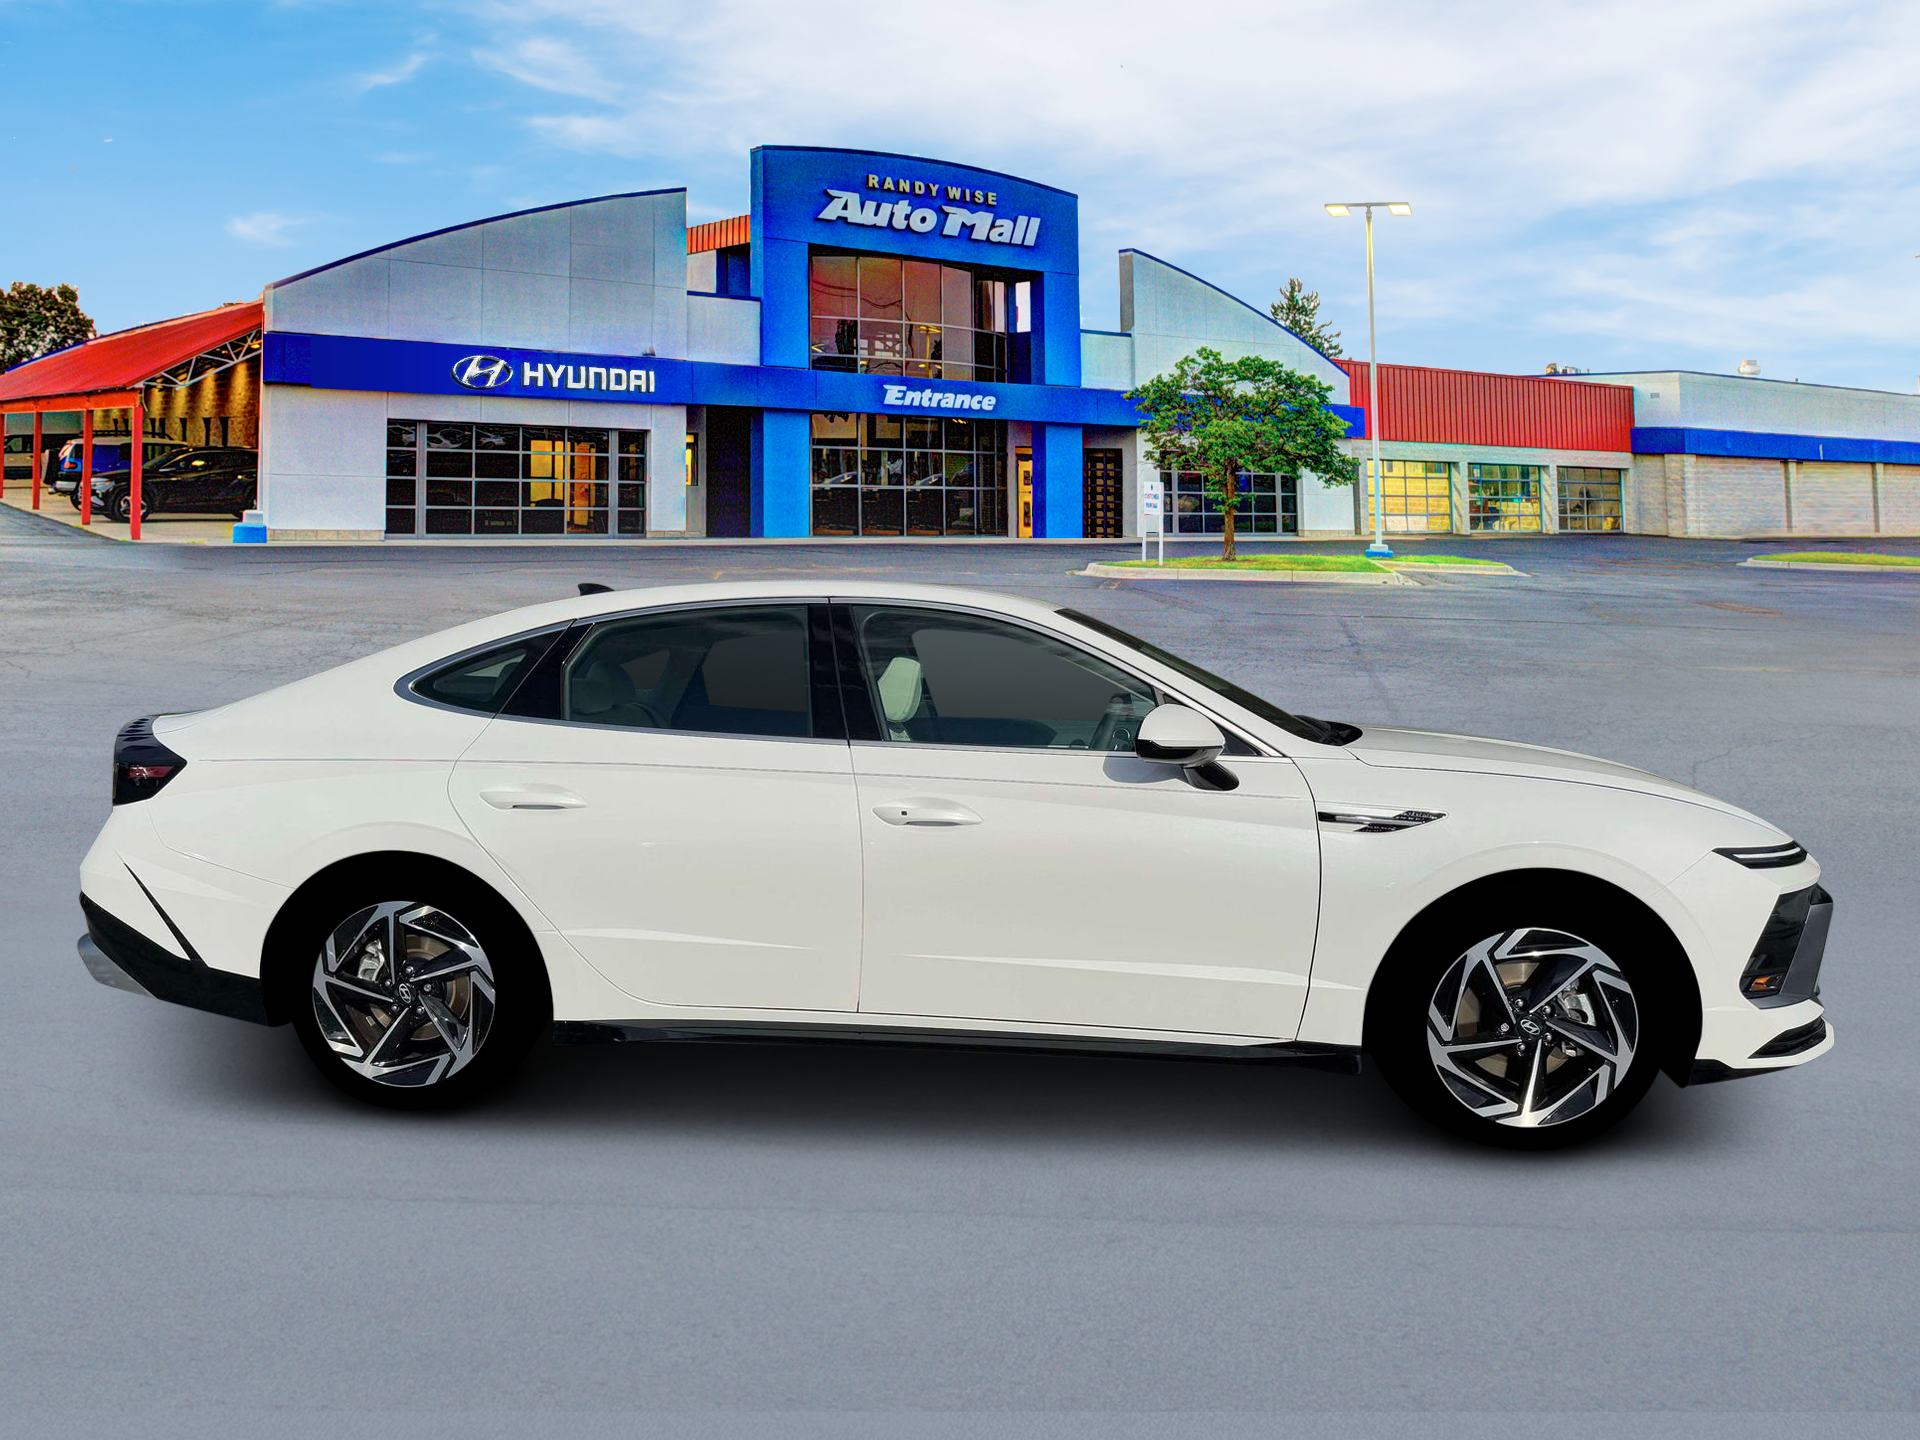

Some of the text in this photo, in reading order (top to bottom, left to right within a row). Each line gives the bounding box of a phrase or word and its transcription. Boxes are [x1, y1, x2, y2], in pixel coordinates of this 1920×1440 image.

[867, 173, 998, 206] RANDY WISE
[816, 189, 1042, 247] Auto Mall
[522, 362, 656, 394] HYUNDAI
[883, 384, 997, 411] Entrance
